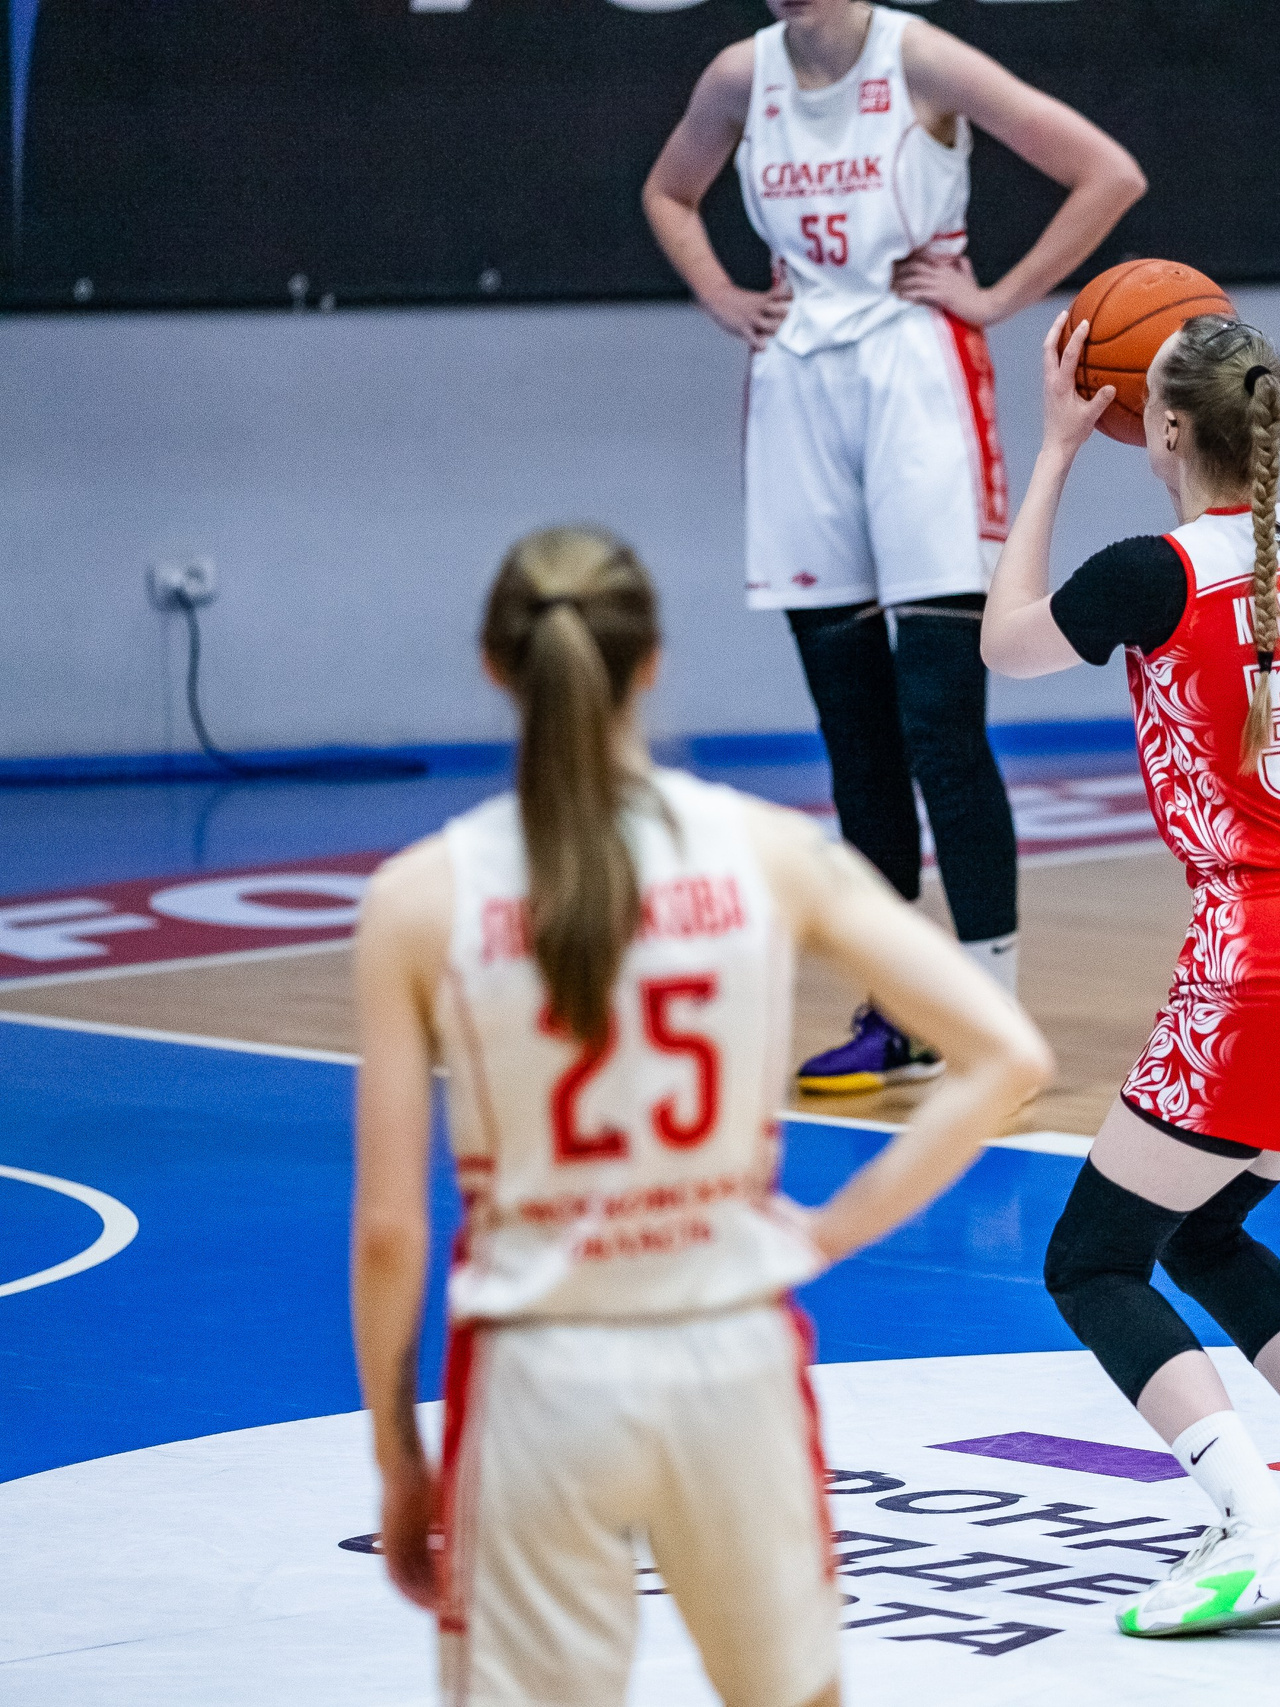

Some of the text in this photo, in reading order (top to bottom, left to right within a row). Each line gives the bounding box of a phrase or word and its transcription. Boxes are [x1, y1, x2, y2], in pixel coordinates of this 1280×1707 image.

[762, 155, 882, 189] СПАРТАК
[801, 213, 849, 267] 55
[536, 972, 721, 1168] 25
